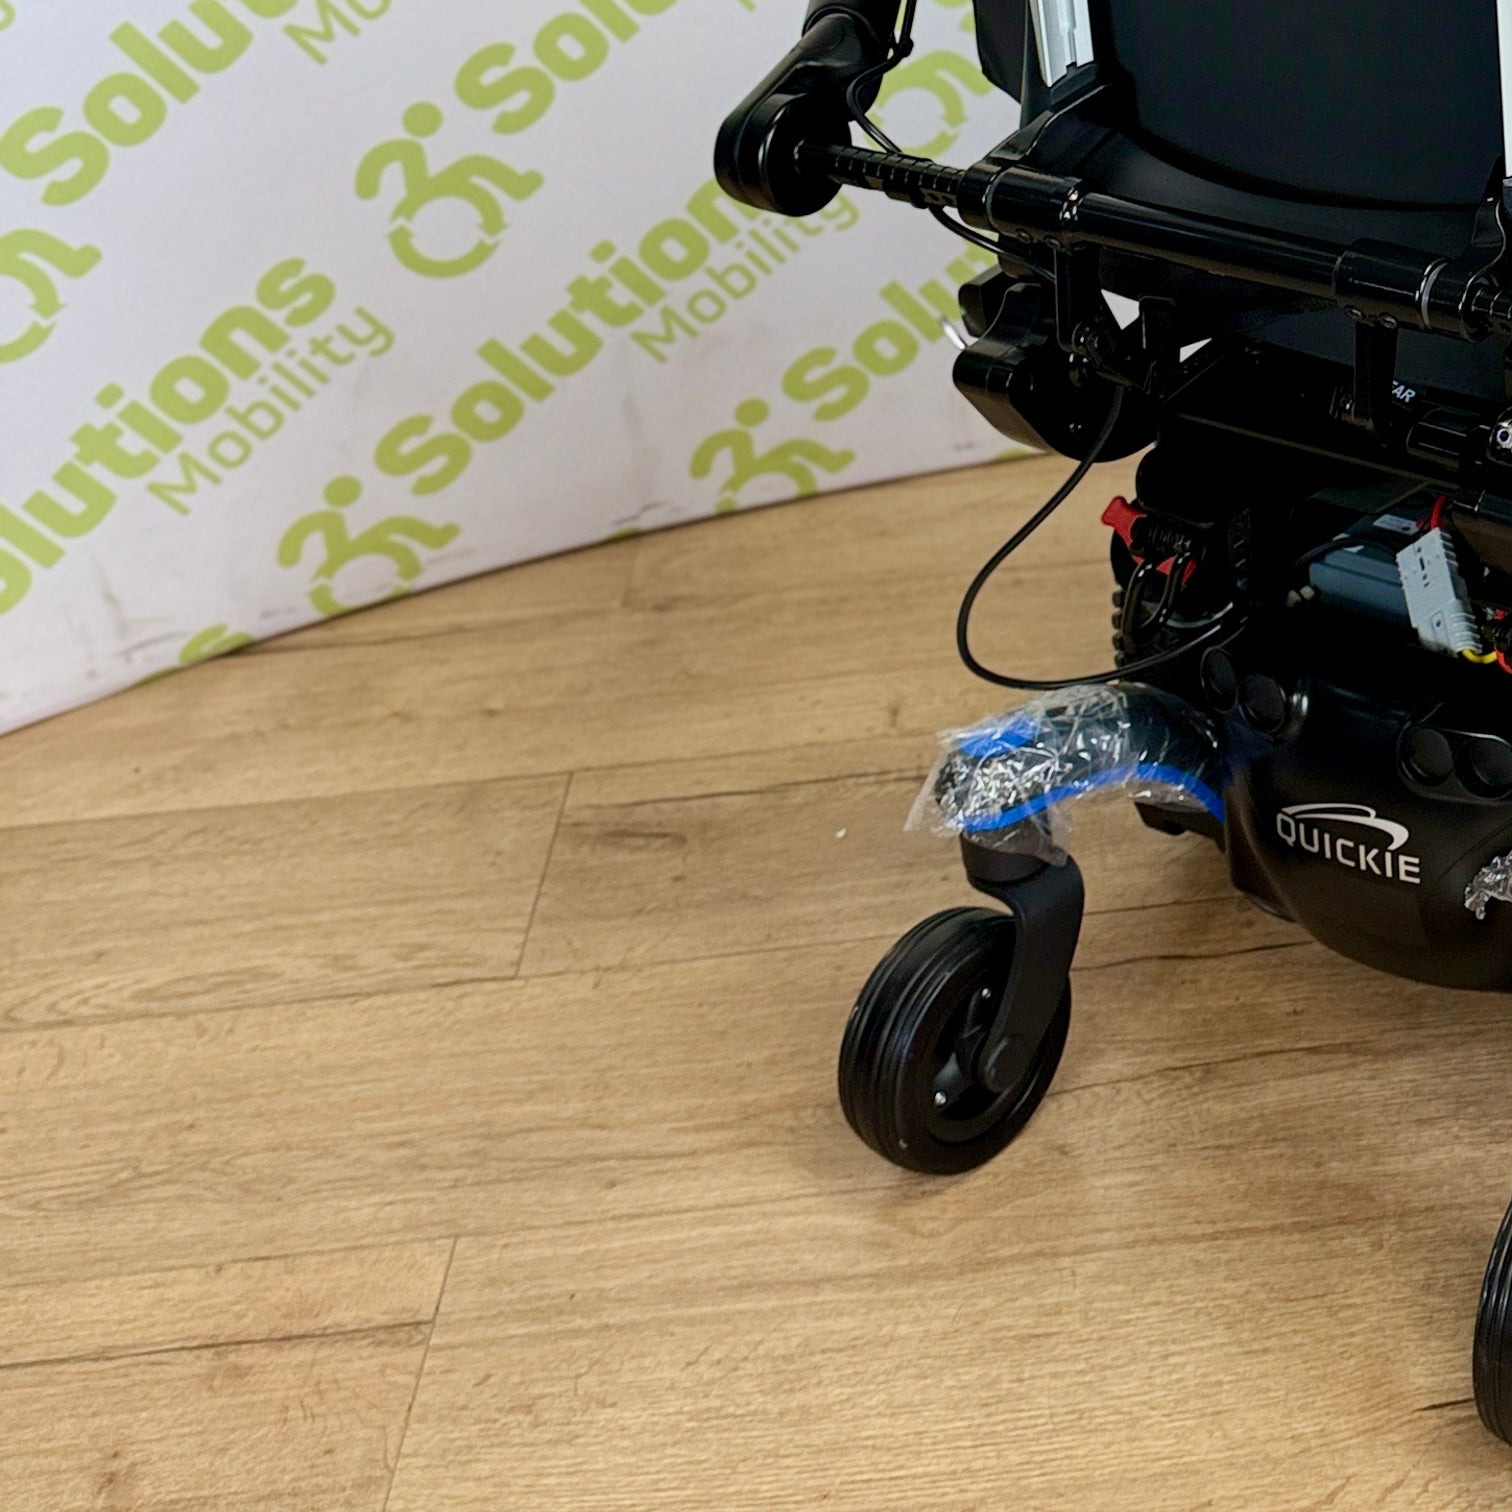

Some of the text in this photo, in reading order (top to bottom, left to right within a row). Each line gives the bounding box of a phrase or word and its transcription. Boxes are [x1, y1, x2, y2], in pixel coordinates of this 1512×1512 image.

[629, 194, 860, 365] Mobility
[145, 304, 396, 516] Mobility
[1276, 812, 1421, 885] QUICKIE
